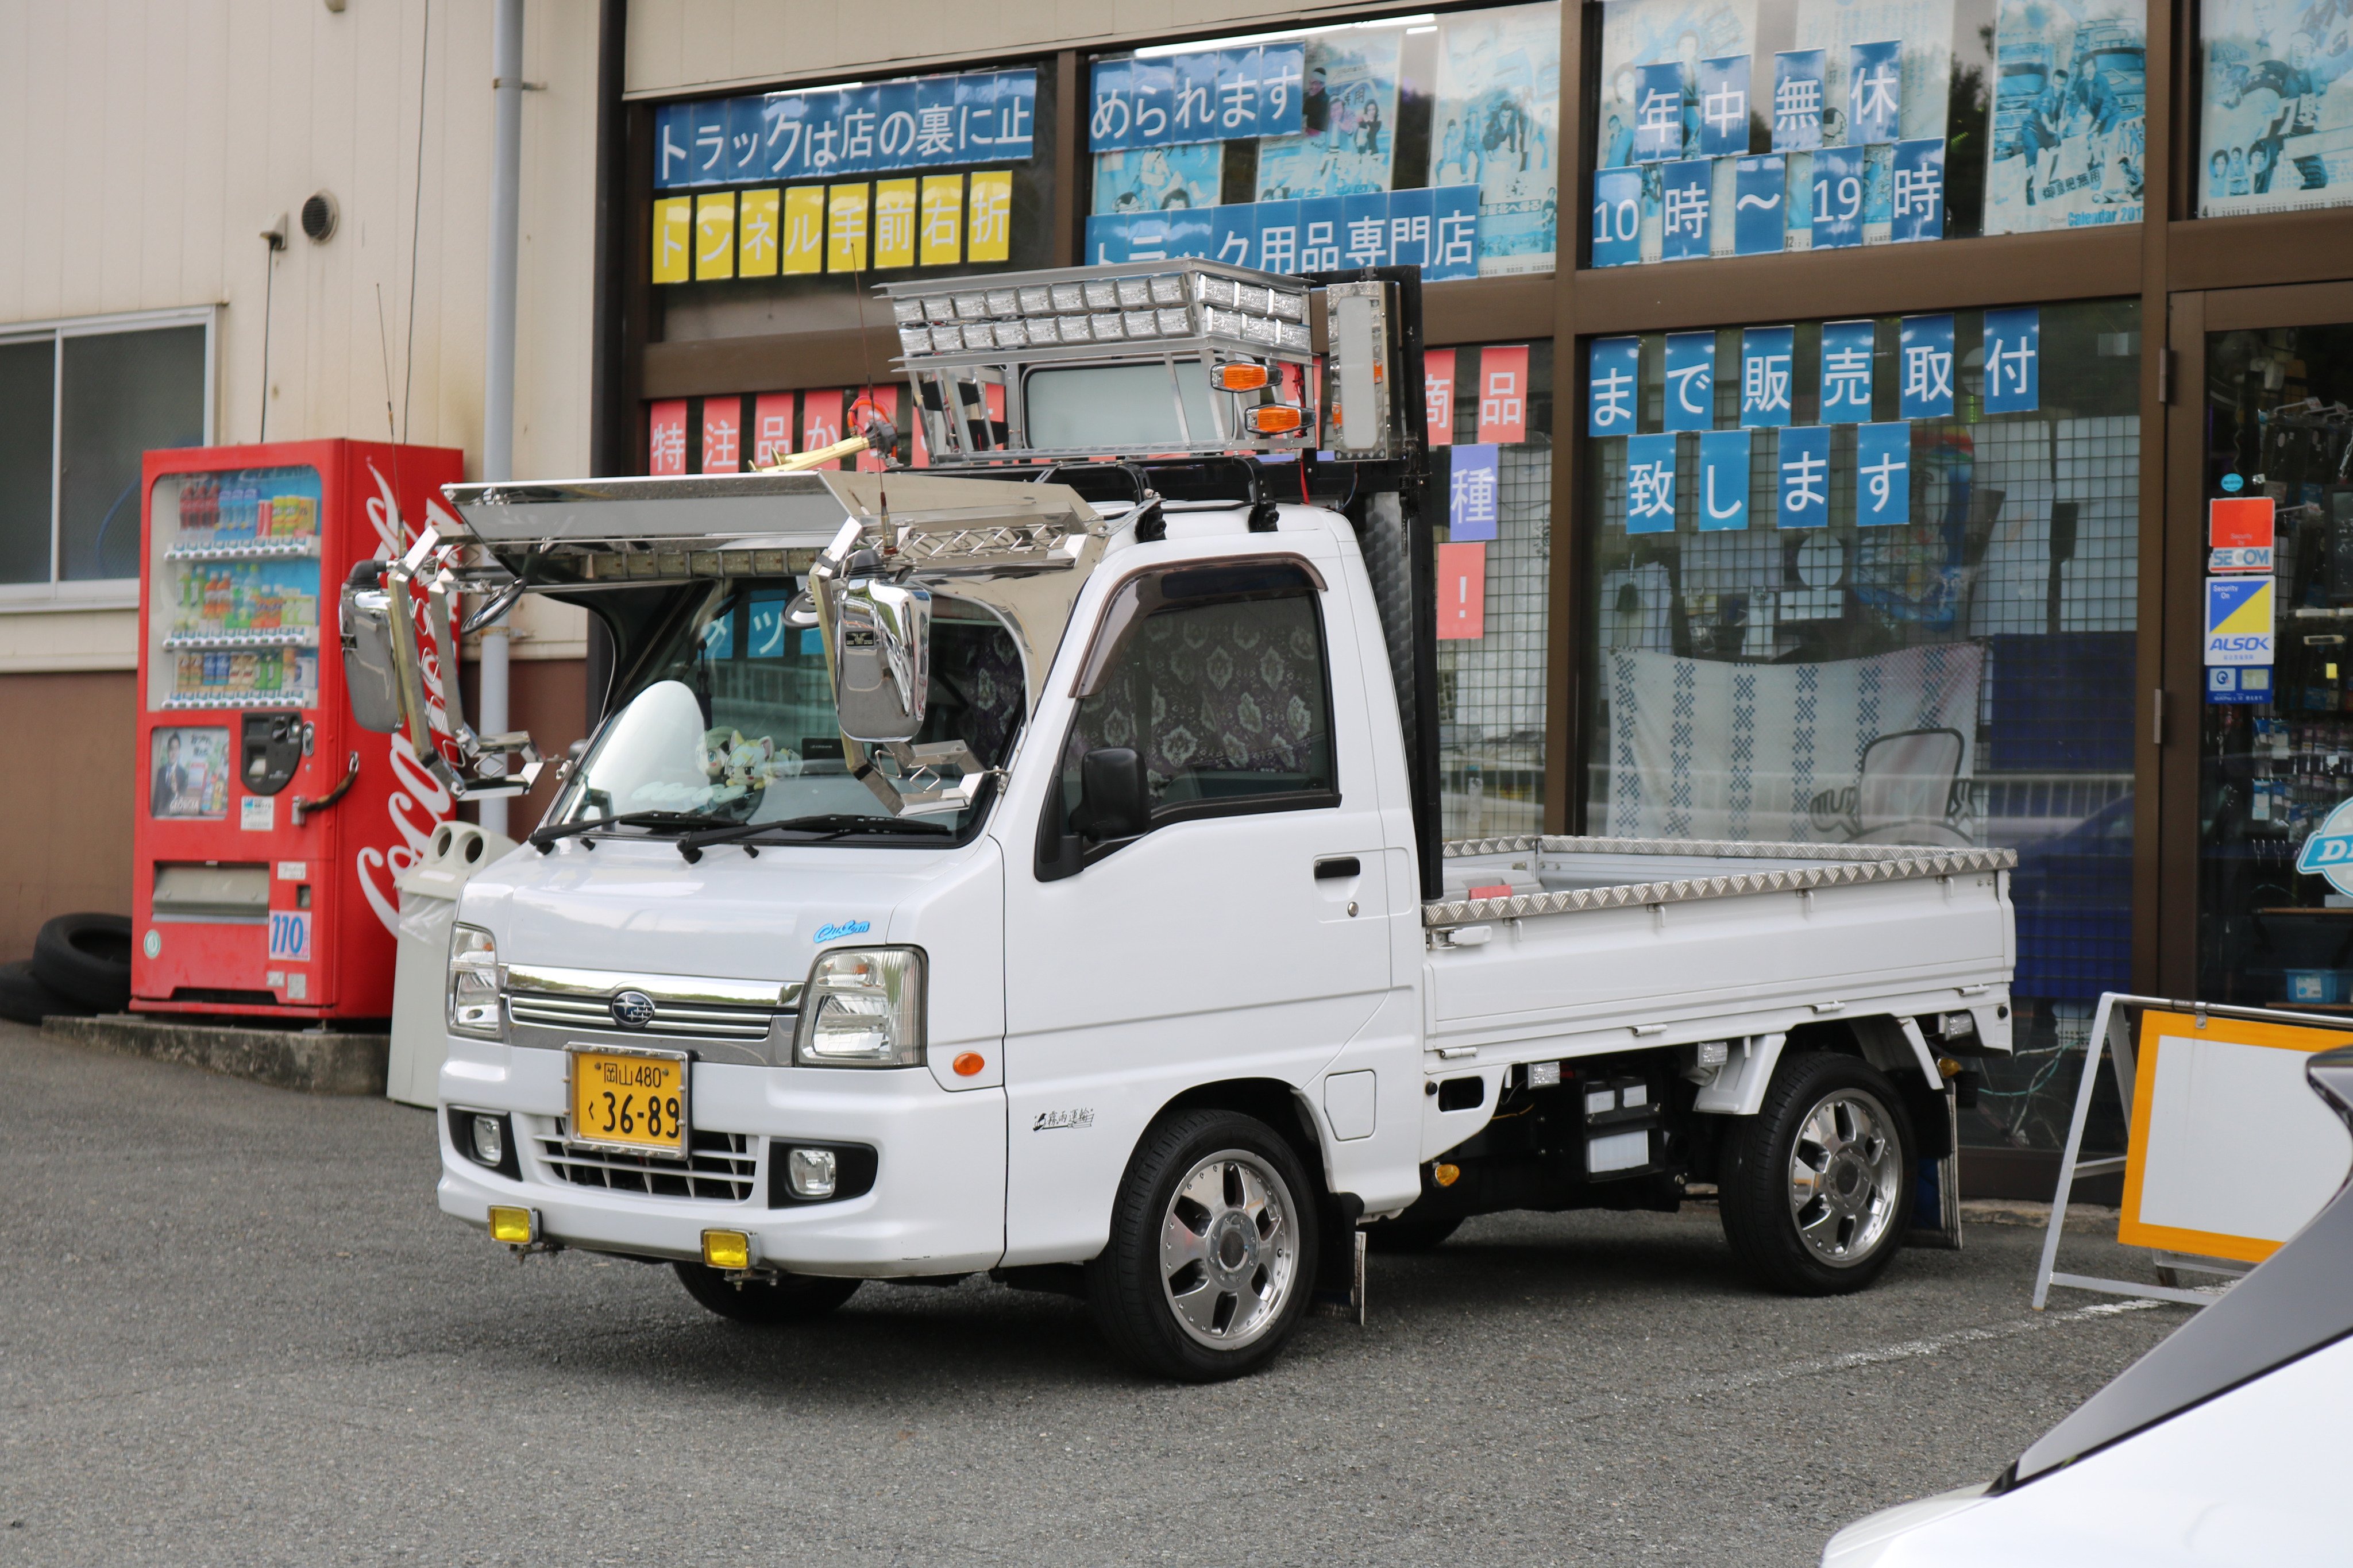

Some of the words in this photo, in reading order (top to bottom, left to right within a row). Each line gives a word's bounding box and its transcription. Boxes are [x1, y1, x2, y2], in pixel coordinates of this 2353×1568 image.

[1091, 66, 1302, 140] められます
[1638, 65, 1897, 143] 年中無休
[662, 95, 1033, 180] トラックは店の裏に止
[663, 193, 1011, 268] トンネル手前右折
[2068, 208, 2117, 226] Calendar
[2121, 206, 2143, 223] 201
[1591, 336, 2036, 427] まで販売取付
[1450, 466, 1496, 524] 種
[1629, 451, 1907, 519] 致します
[2213, 549, 2269, 566] SECOM
[2209, 636, 2270, 651] ALSOK
[272, 913, 304, 955] 110
[813, 920, 870, 943] Custom
[603, 1091, 680, 1138] 36-89
